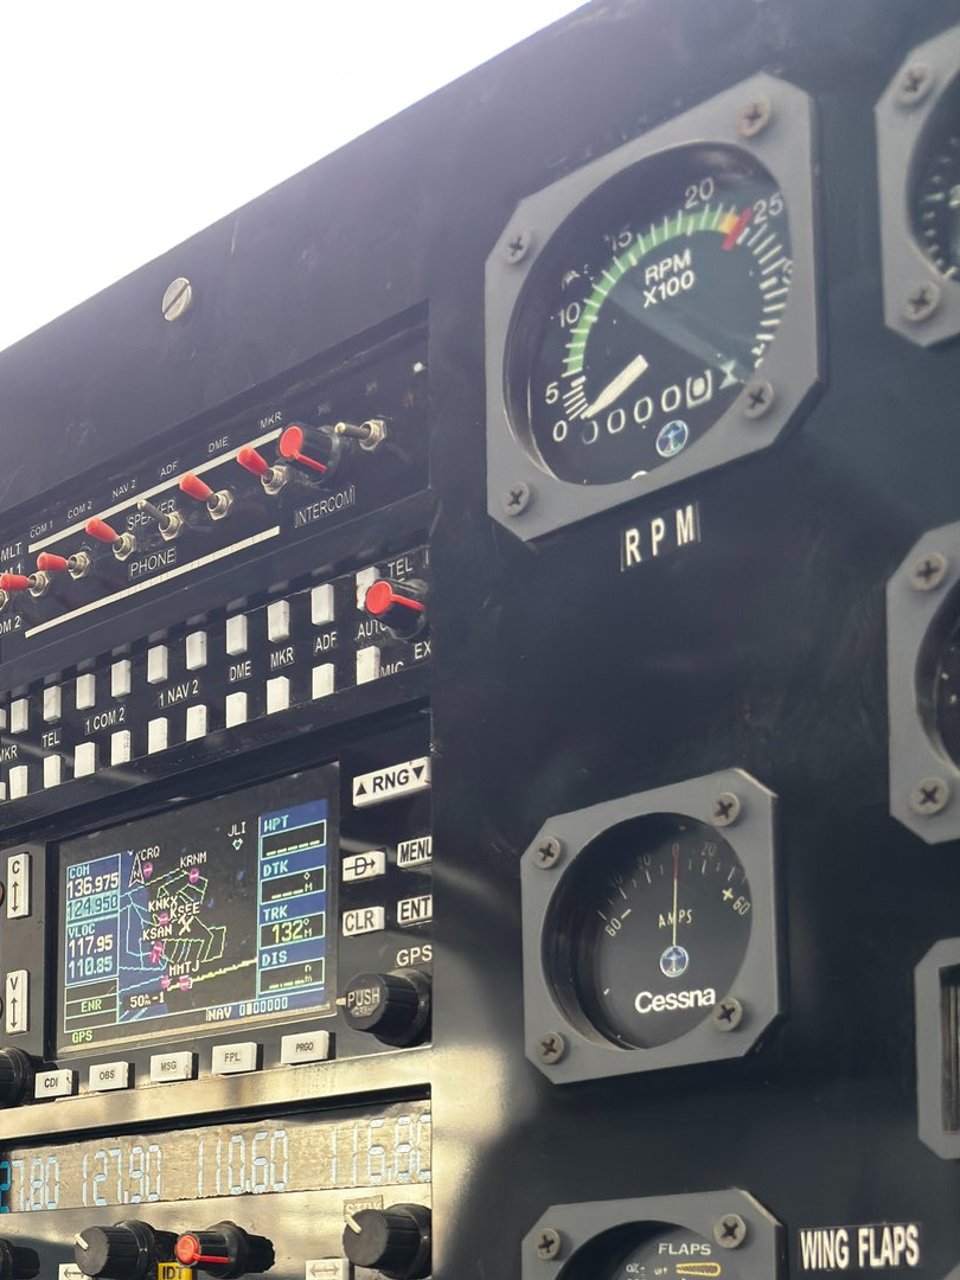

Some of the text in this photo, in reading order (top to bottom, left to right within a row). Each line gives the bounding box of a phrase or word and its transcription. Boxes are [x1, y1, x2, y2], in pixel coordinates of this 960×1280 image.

[685, 177, 714, 208] 20
[753, 193, 783, 223] 25
[645, 249, 692, 284] RPM
[643, 270, 695, 308] X100
[558, 302, 580, 327] 10
[546, 382, 559, 403] 5
[260, 412, 282, 429] MKR
[208, 436, 228, 453] DME
[160, 461, 178, 478] ADF
[112, 484, 130, 498] NAV
[67, 504, 86, 518] COM
[295, 488, 352, 528] INTERCOM
[30, 522, 48, 538] COM
[130, 551, 175, 578] PHONE
[388, 558, 413, 576] TEL
[14, 616, 22, 629] 2
[314, 632, 337, 654] ADF
[270, 648, 294, 668] MKR
[230, 661, 251, 680] DME
[167, 684, 189, 703] NAV
[192, 680, 198, 694] 2
[93, 713, 117, 730] COM
[119, 708, 125, 722] 2
[42, 731, 60, 748] TEL
[372, 768, 409, 791] RNG
[12, 860, 20, 875] C
[180, 852, 207, 868] KRNM
[263, 860, 288, 876] DTK
[67, 872, 119, 898] 136.975
[68, 895, 118, 920] 124.950
[263, 905, 288, 922] TRK
[400, 897, 431, 921] ENT
[345, 909, 375, 932] CLR
[658, 909, 692, 928] AMPS
[68, 923, 96, 938] VLOC
[143, 926, 172, 941] KSAN
[69, 934, 113, 958] 117.95
[262, 950, 287, 967] DIS
[396, 944, 432, 968] GPS
[69, 956, 113, 979] 110.85
[10, 977, 17, 991] V
[82, 1000, 102, 1013] ENR
[348, 988, 380, 1008] PUSH
[635, 988, 716, 1013] Cessna
[208, 1007, 232, 1020] NAV
[72, 1029, 93, 1043] GPS
[160, 1059, 177, 1073] MSG
[224, 1050, 240, 1064] FPL
[44, 1076, 58, 1089] CDI
[99, 1068, 116, 1082] OBS
[659, 1243, 711, 1255] FLAPS
[800, 1225, 919, 1270] WING FLAPS
